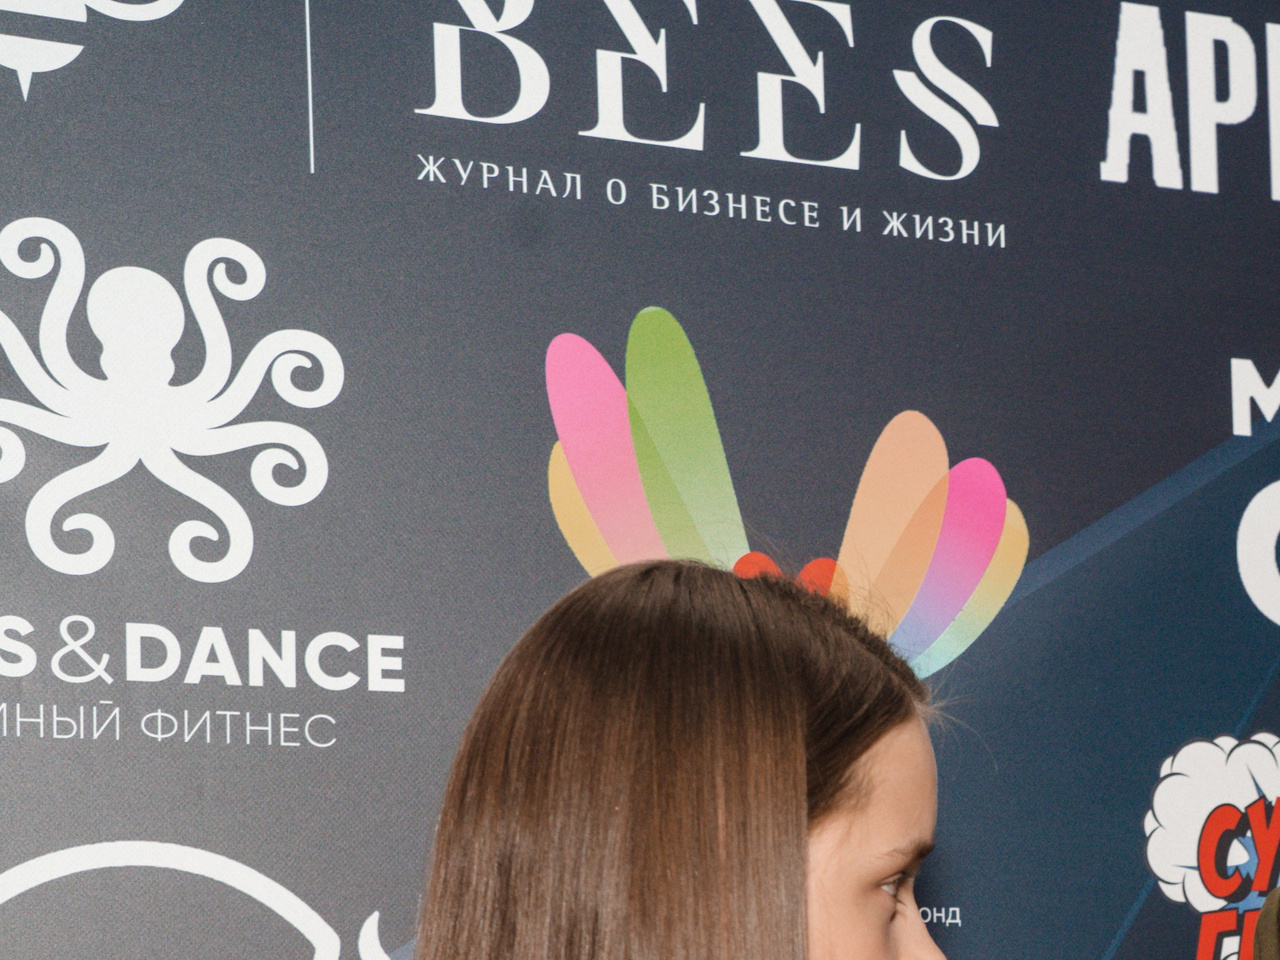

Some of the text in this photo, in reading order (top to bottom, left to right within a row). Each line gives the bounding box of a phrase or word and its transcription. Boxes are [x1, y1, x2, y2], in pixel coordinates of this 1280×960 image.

[413, 0, 1000, 181] BEES
[416, 153, 1008, 249] ЖУРНАЛ О БИЗНЕСЕ И ЖИЗНИ
[0, 699, 338, 748] НЫЙ ФИТНЕС
